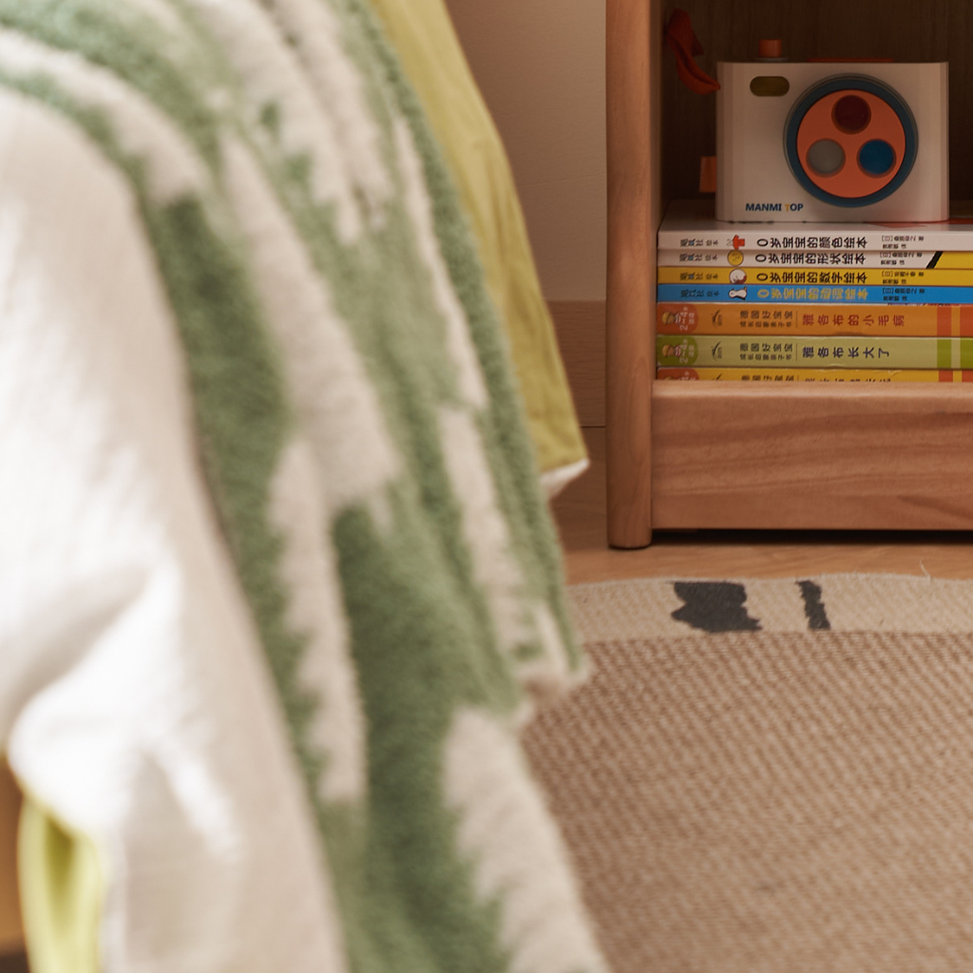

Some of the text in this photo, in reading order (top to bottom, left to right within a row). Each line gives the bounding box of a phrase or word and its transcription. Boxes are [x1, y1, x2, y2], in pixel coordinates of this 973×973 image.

[745, 203, 804, 212] MANMI TOP
[757, 236, 868, 249] 0岁宝宝的颜色绘本
[755, 252, 866, 265] 0岁宝宝的形状绘本
[757, 271, 868, 284] 0岁宝宝的数字绘本
[802, 314, 905, 326] 雅各布的小毛病
[802, 346, 890, 358] 雅各布长大了
